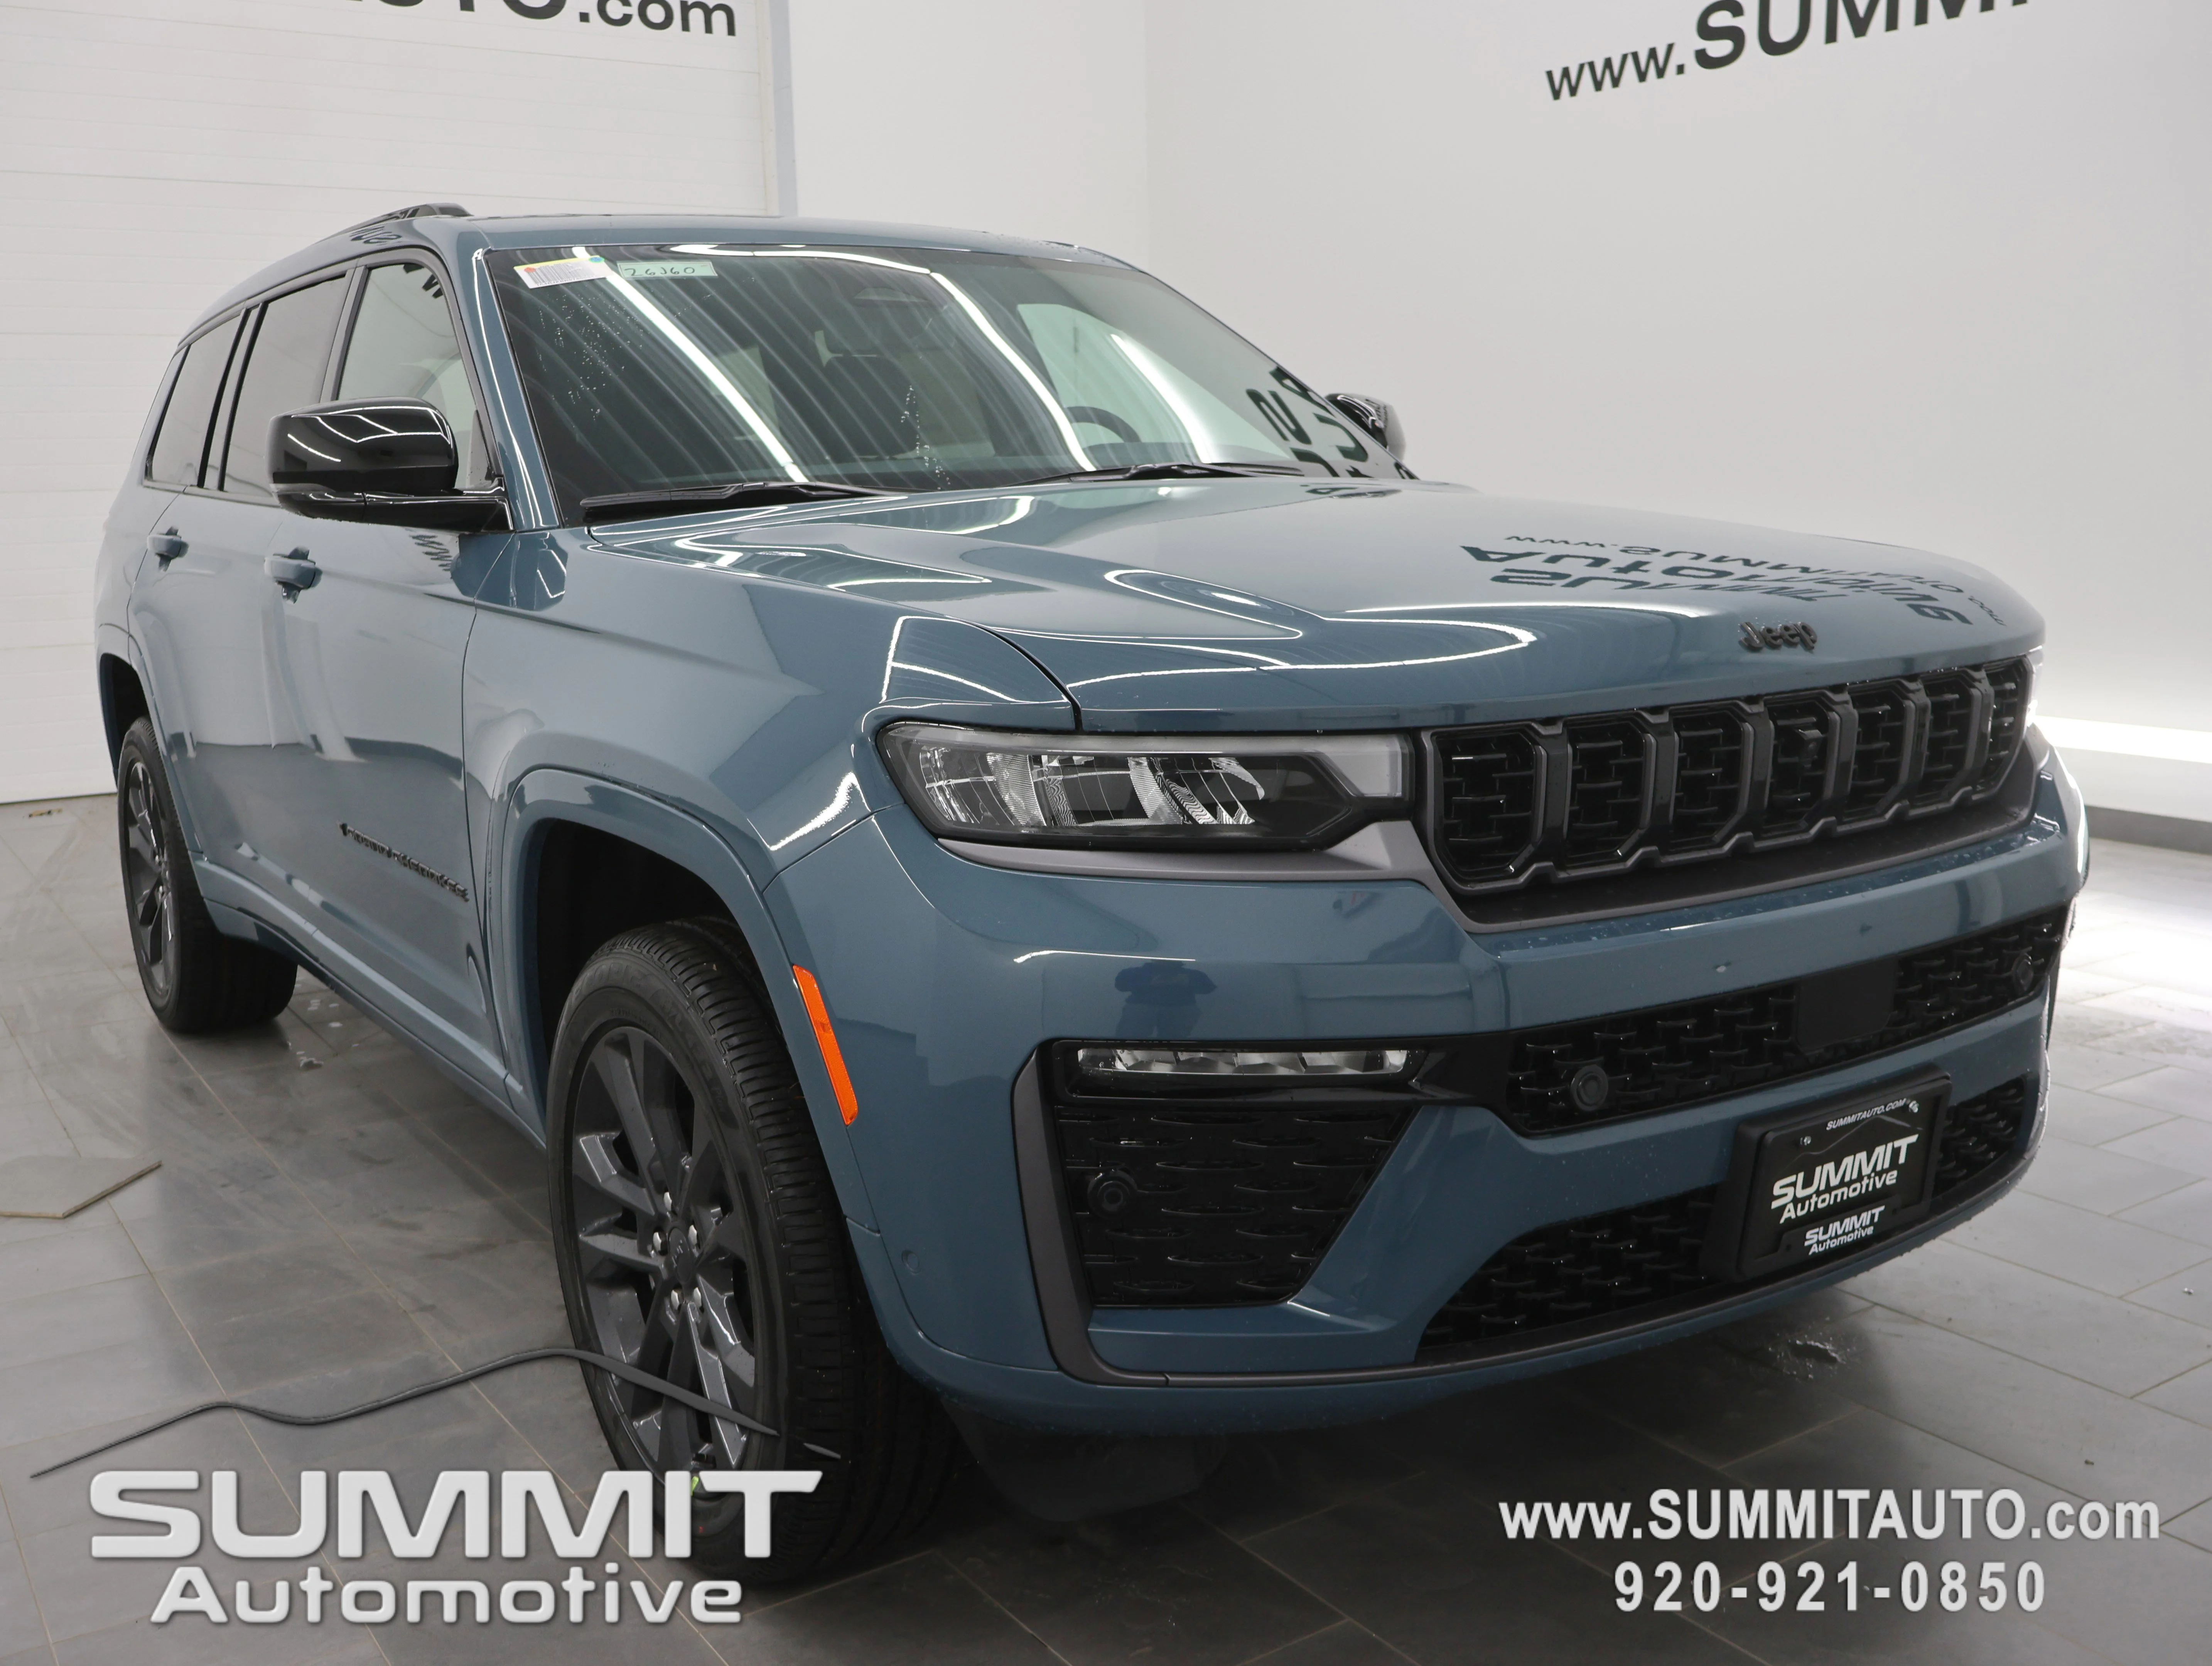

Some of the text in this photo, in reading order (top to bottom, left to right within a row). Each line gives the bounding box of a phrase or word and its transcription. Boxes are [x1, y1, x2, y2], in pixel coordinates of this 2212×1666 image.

[1738, 622, 1817, 652] Jeep
[1826, 1098, 1907, 1130] SUMMITAUTO.COM
[1771, 1134, 1918, 1209] SUMMIT
[1780, 1170, 1898, 1224] Automotive
[1804, 1206, 1885, 1246] SUMMIT
[1809, 1226, 1874, 1255] Automotive
